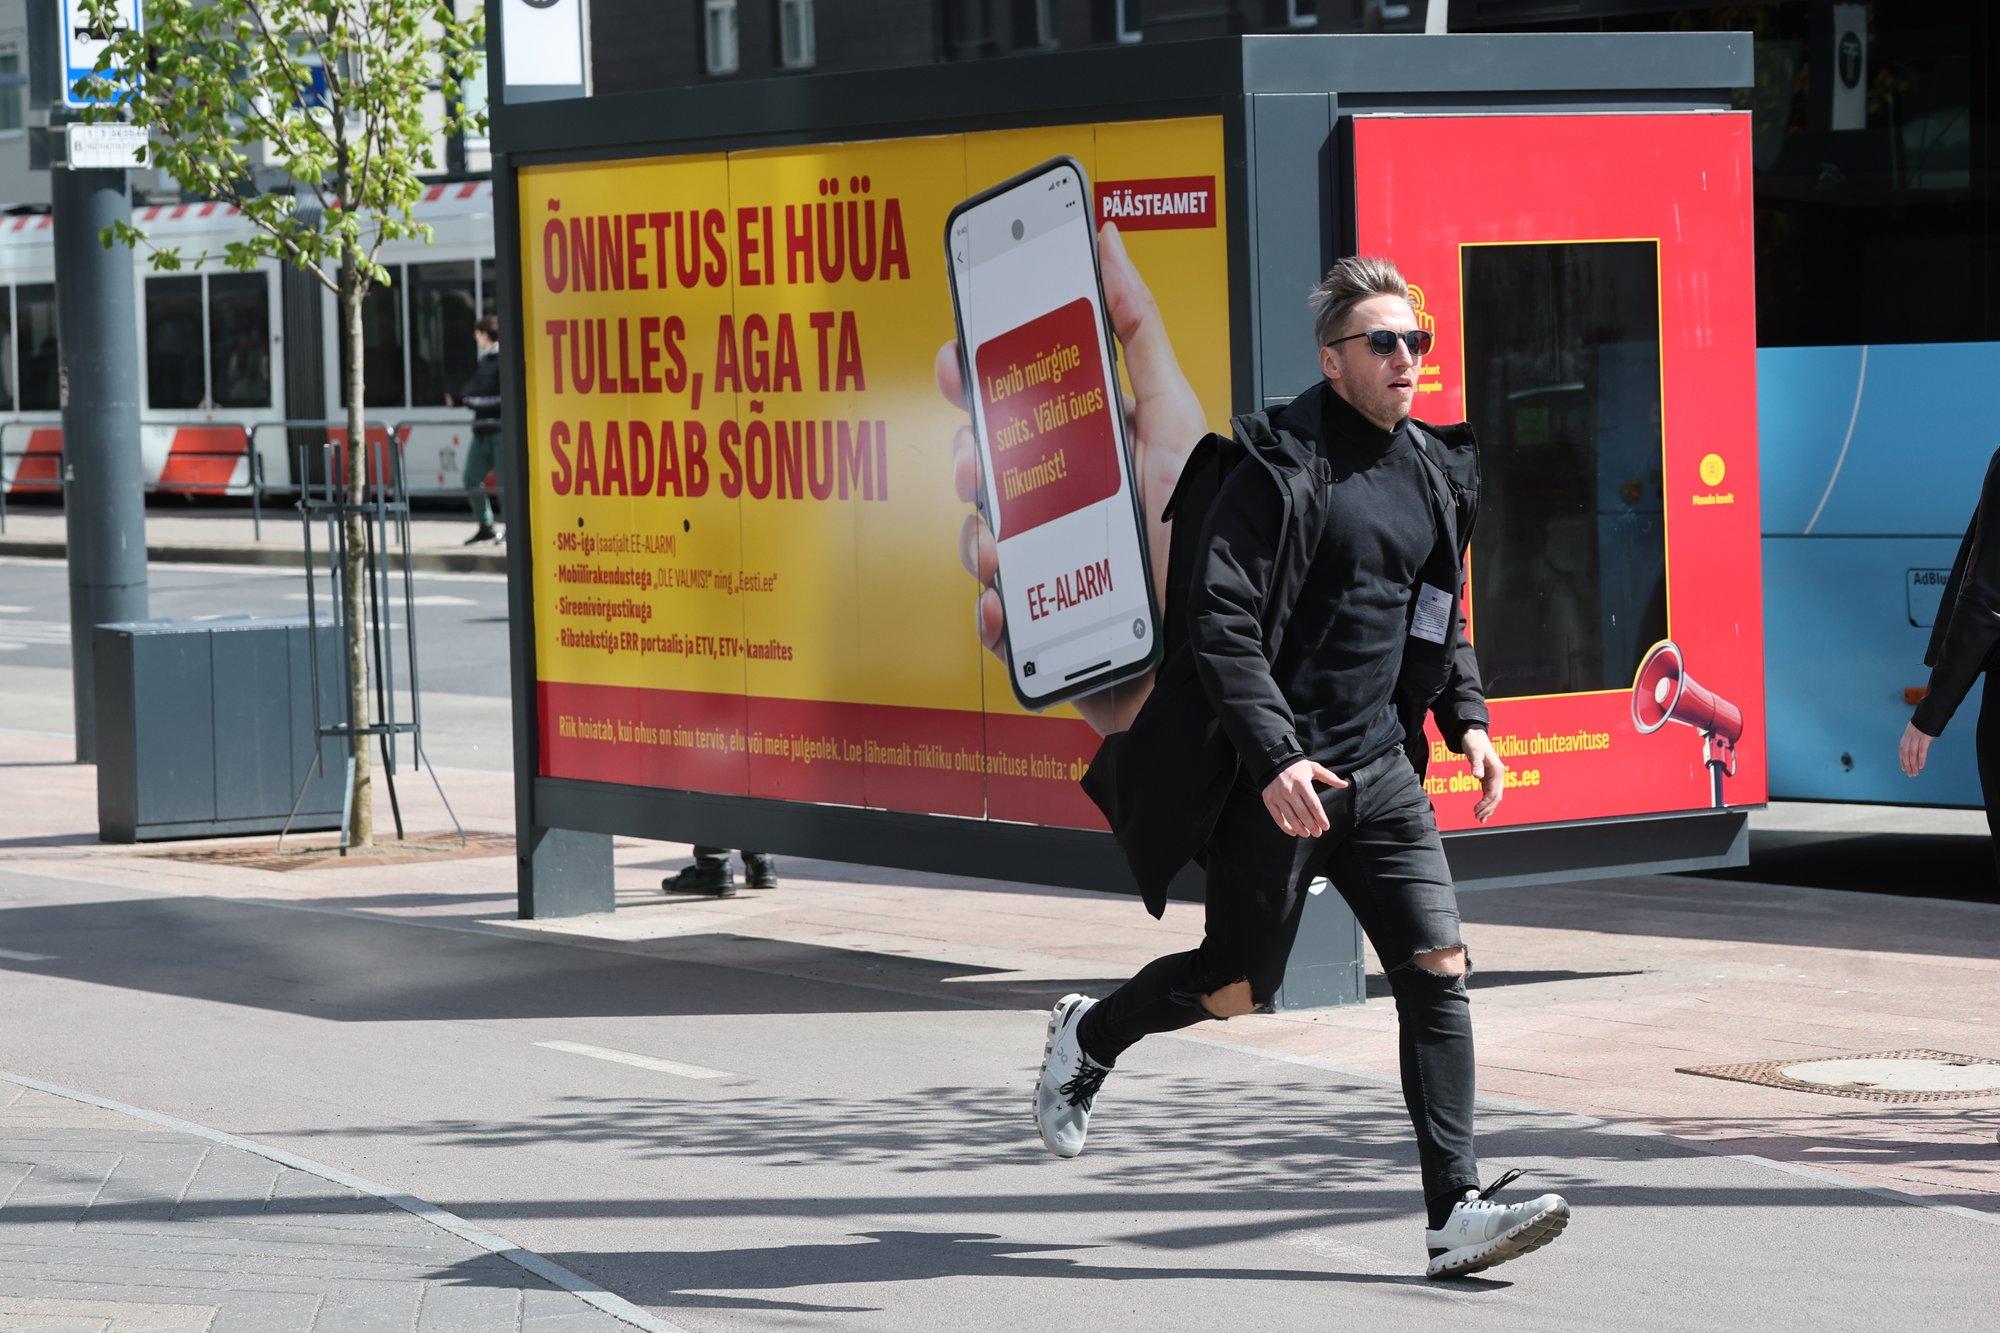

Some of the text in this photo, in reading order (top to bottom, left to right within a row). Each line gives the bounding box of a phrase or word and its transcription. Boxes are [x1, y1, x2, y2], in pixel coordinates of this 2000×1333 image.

[1103, 189, 1208, 218] PÄÄSTEAMET
[543, 175, 911, 294] ÕNNETUS EI HÜÜA
[545, 311, 866, 410] TULLES, AGA TA
[987, 343, 1081, 403] Levib mürgine
[996, 387, 1104, 452] suits. Väldi õues
[550, 400, 888, 501] SAADAB SÕNUMI
[1002, 449, 1068, 501] liikumist!
[557, 532, 595, 556] SMS-iga
[631, 534, 676, 558] EE-ALARM)
[559, 564, 652, 591] Mobiilirakendustega
[714, 570, 733, 595] ning
[1027, 558, 1113, 621] EE-ALARM
[559, 596, 652, 623] Sireenivõrgustikuga
[561, 628, 618, 654] Ribatekstiga
[620, 632, 638, 651] ERR
[641, 634, 683, 656] portaalis
[685, 634, 694, 658] ja
[695, 636, 717, 660] ETV,
[746, 639, 793, 661] kanalites
[559, 715, 577, 738] Riik
[578, 716, 616, 744] hoiatab,
[618, 719, 632, 742] kui
[635, 721, 657, 744] ohus
[659, 728, 671, 745] on
[674, 724, 694, 747] sinu
[695, 727, 728, 754] tervis,
[729, 729, 745, 751] elu
[748, 732, 762, 754] või
[765, 733, 789, 756] meie
[791, 734, 841, 764] julgeolek.
[843, 739, 861, 762] Loe
[865, 739, 911, 767] lähemalt
[914, 743, 952, 770] riikliku
[955, 747, 1027, 776] ohuteavituse
[1031, 753, 1067, 780] kohta:
[1491, 735, 1528, 757] iikliku
[1530, 730, 1610, 755] ohuteavituse
[1449, 765, 1540, 793] olevis.ee
